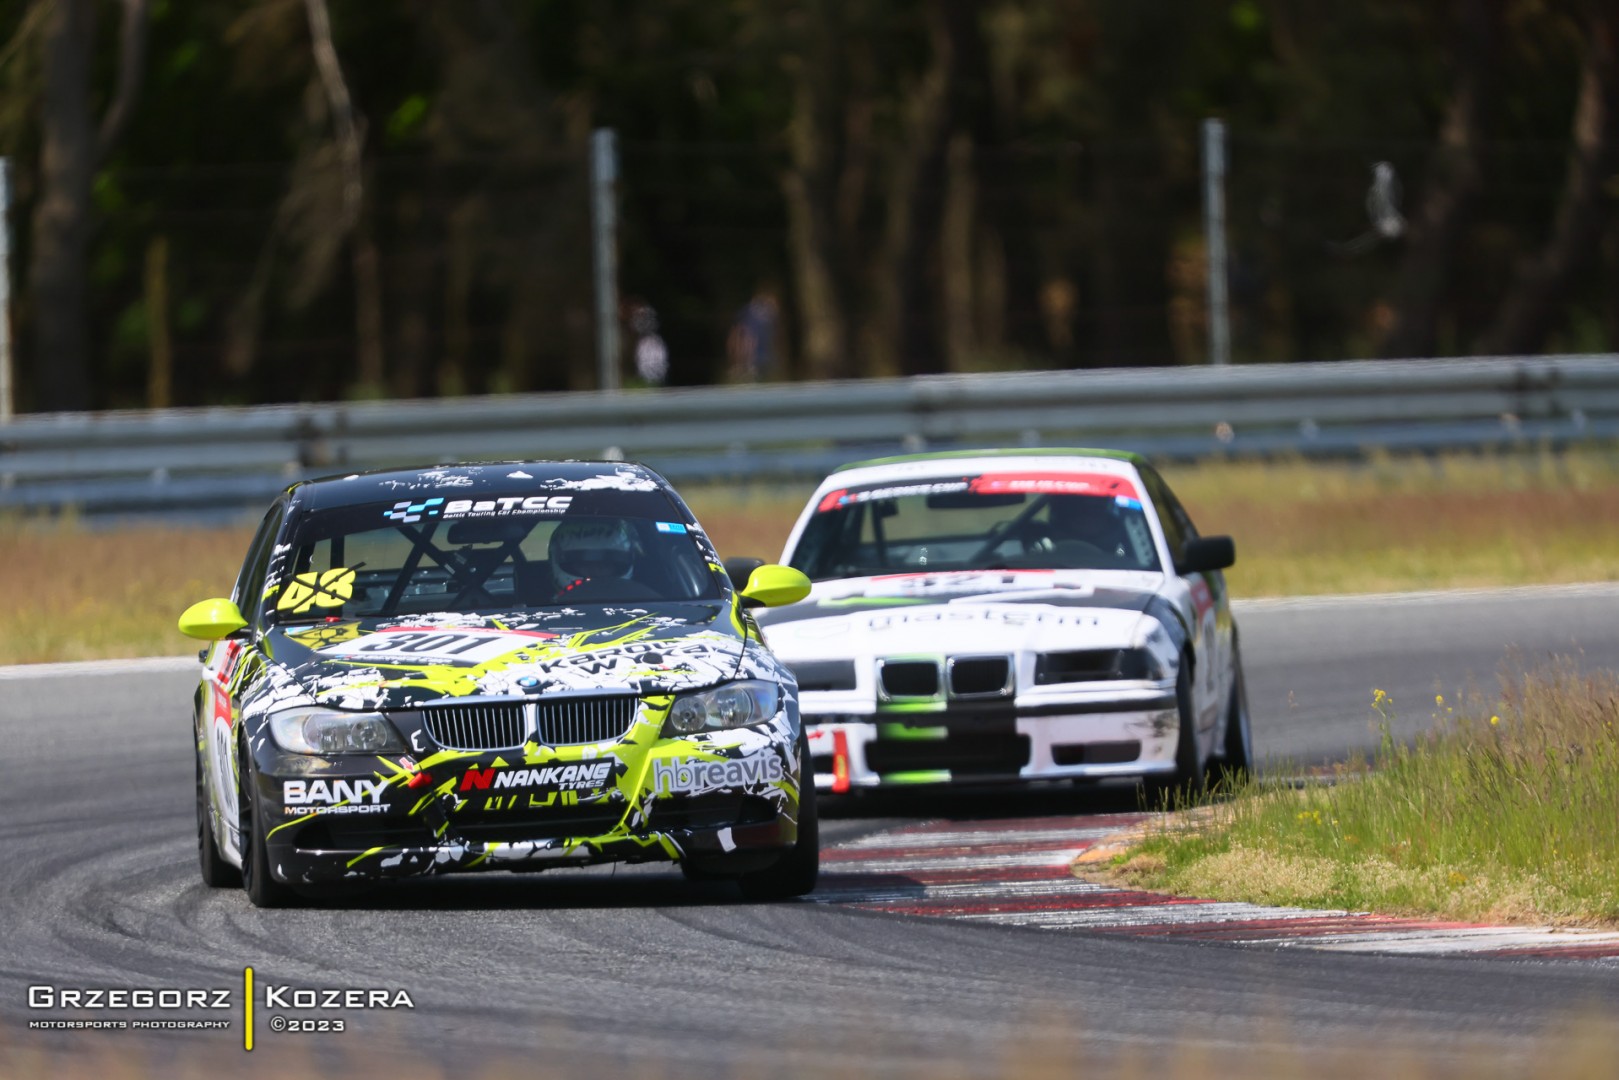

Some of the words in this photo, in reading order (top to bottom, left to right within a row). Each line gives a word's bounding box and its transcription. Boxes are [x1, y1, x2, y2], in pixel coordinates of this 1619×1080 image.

[444, 496, 573, 514] BaTCC
[467, 509, 496, 518] Touring
[511, 507, 567, 516] Championship
[358, 632, 503, 655] 301
[493, 763, 611, 789] NANKANG
[655, 751, 781, 790] hbreavis
[284, 779, 391, 804] BANY
[558, 779, 605, 791] TYRES
[284, 803, 391, 816] MOTORSPORT
